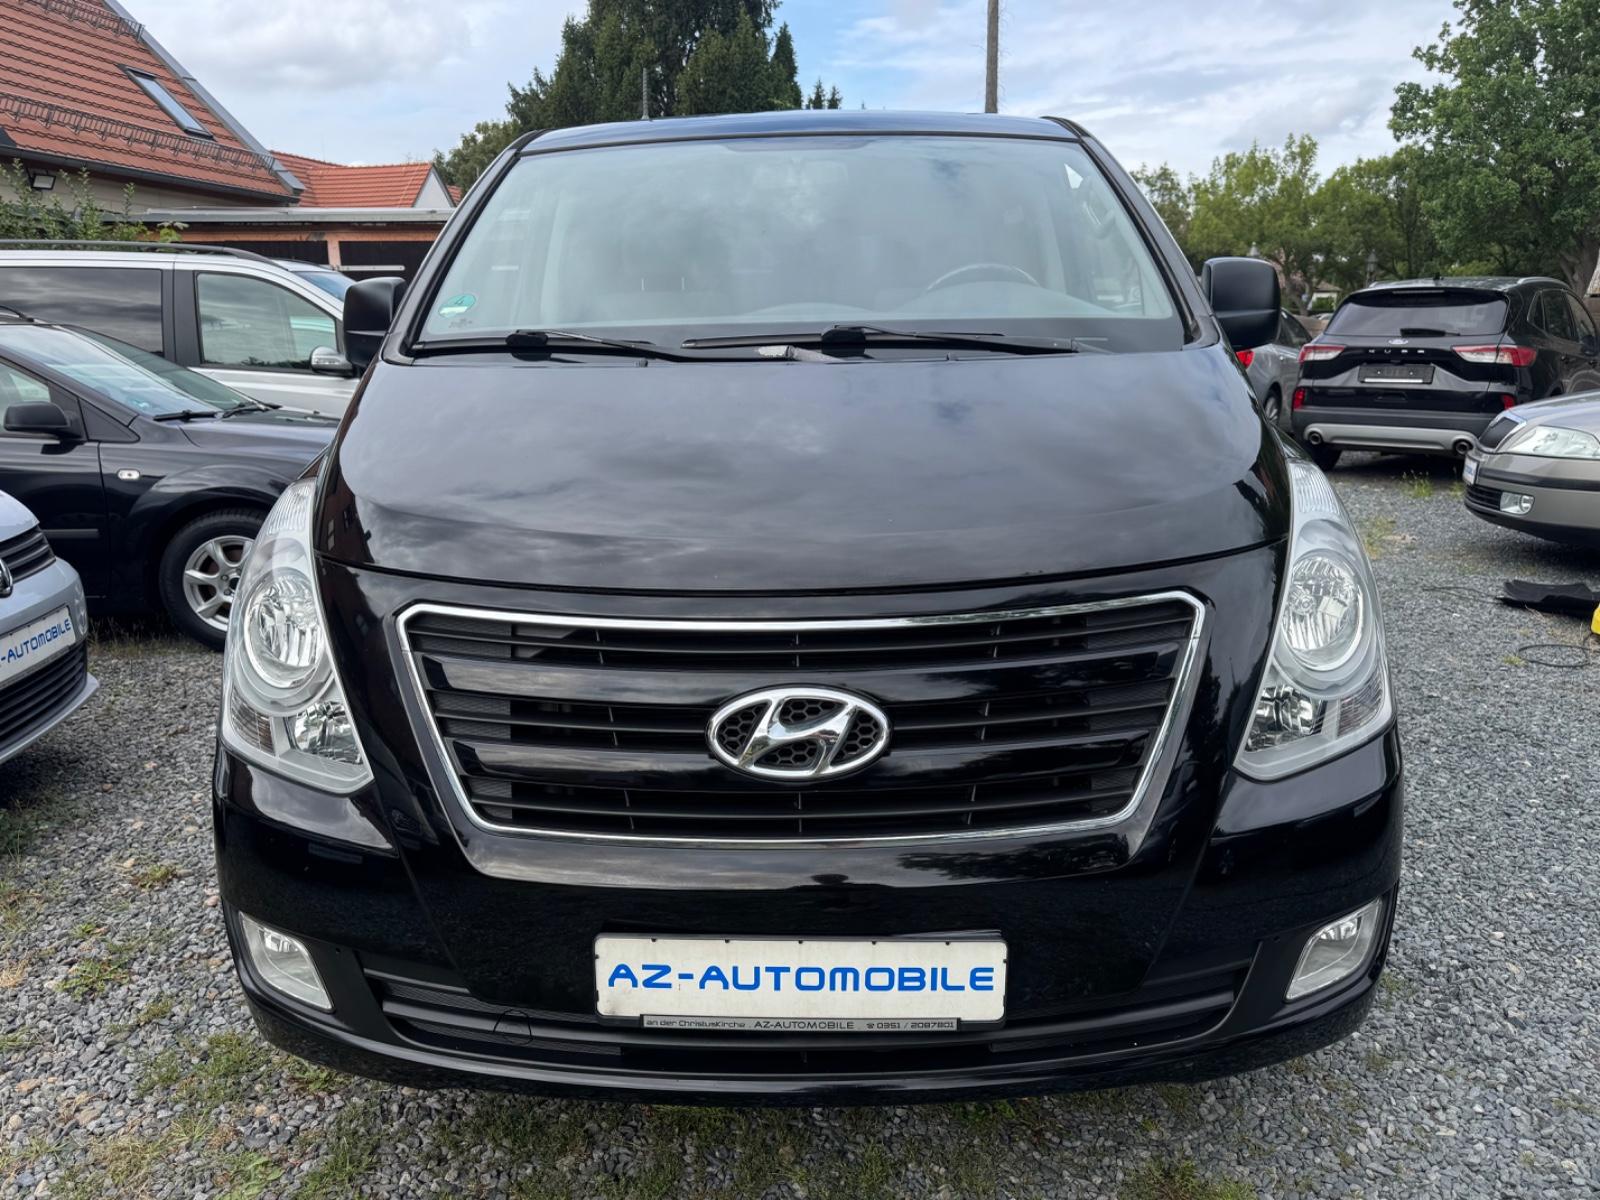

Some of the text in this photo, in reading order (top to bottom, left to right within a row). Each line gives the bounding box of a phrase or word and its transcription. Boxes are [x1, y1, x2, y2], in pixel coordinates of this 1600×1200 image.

[0, 618, 71, 667] -AUTOMOBILE
[608, 963, 994, 992] AZ-AUTOMOBILE
[754, 1021, 855, 1030] AZ-AUTOMOBILE
